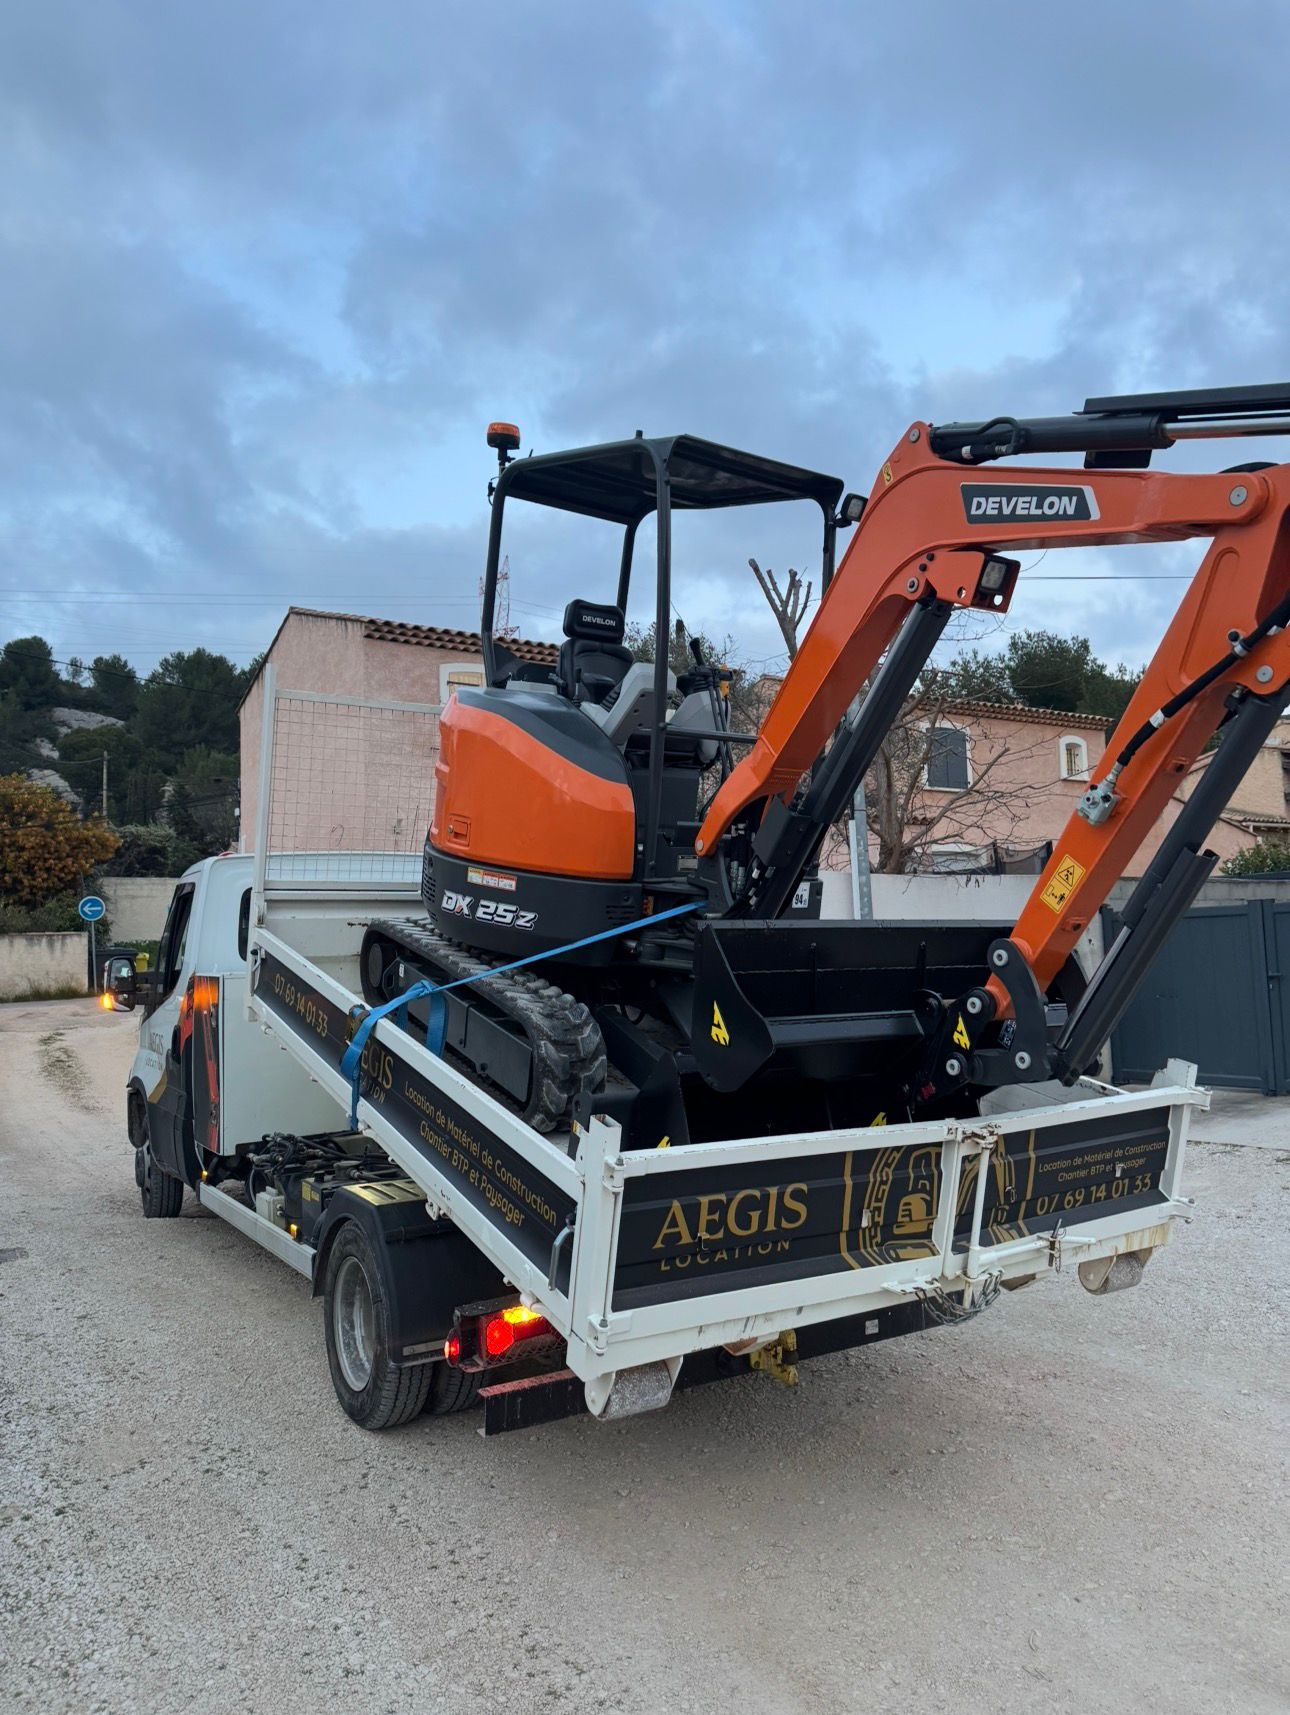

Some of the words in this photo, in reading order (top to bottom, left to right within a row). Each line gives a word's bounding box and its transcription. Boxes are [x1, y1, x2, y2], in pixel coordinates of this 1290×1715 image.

[970, 495, 1077, 515] DEVELON
[582, 615, 616, 627] DEVELON
[441, 889, 474, 920] DX
[274, 973, 285, 996] 07
[285, 983, 296, 1007] 69
[296, 992, 305, 1017] 14
[306, 1001, 316, 1027] 01
[316, 1010, 328, 1038] 33
[361, 1041, 394, 1089] EGIS
[404, 1081, 435, 1119] Location
[435, 1108, 446, 1128] de
[447, 1117, 480, 1158] Matériel
[481, 1149, 493, 1169] de
[494, 1160, 557, 1226] Construction
[420, 1120, 451, 1158] Chantier
[451, 1149, 469, 1174] BTP
[469, 1169, 480, 1187] et
[480, 1176, 525, 1227] Paysager
[1038, 1159, 1071, 1173] Location
[1072, 1156, 1082, 1166] de
[1084, 1150, 1113, 1164] Matériel
[1114, 1148, 1123, 1157] de
[1124, 1140, 1166, 1155] Construction
[1058, 1167, 1089, 1182] Chantier
[1090, 1164, 1105, 1176] BTP
[1105, 1163, 1113, 1173] et
[652, 1182, 808, 1249] AEGIS
[1036, 1193, 1060, 1216] 07
[1063, 1188, 1085, 1210] 69
[1090, 1183, 1107, 1203] 14
[1111, 1178, 1129, 1199] 01
[1133, 1172, 1152, 1194] 33
